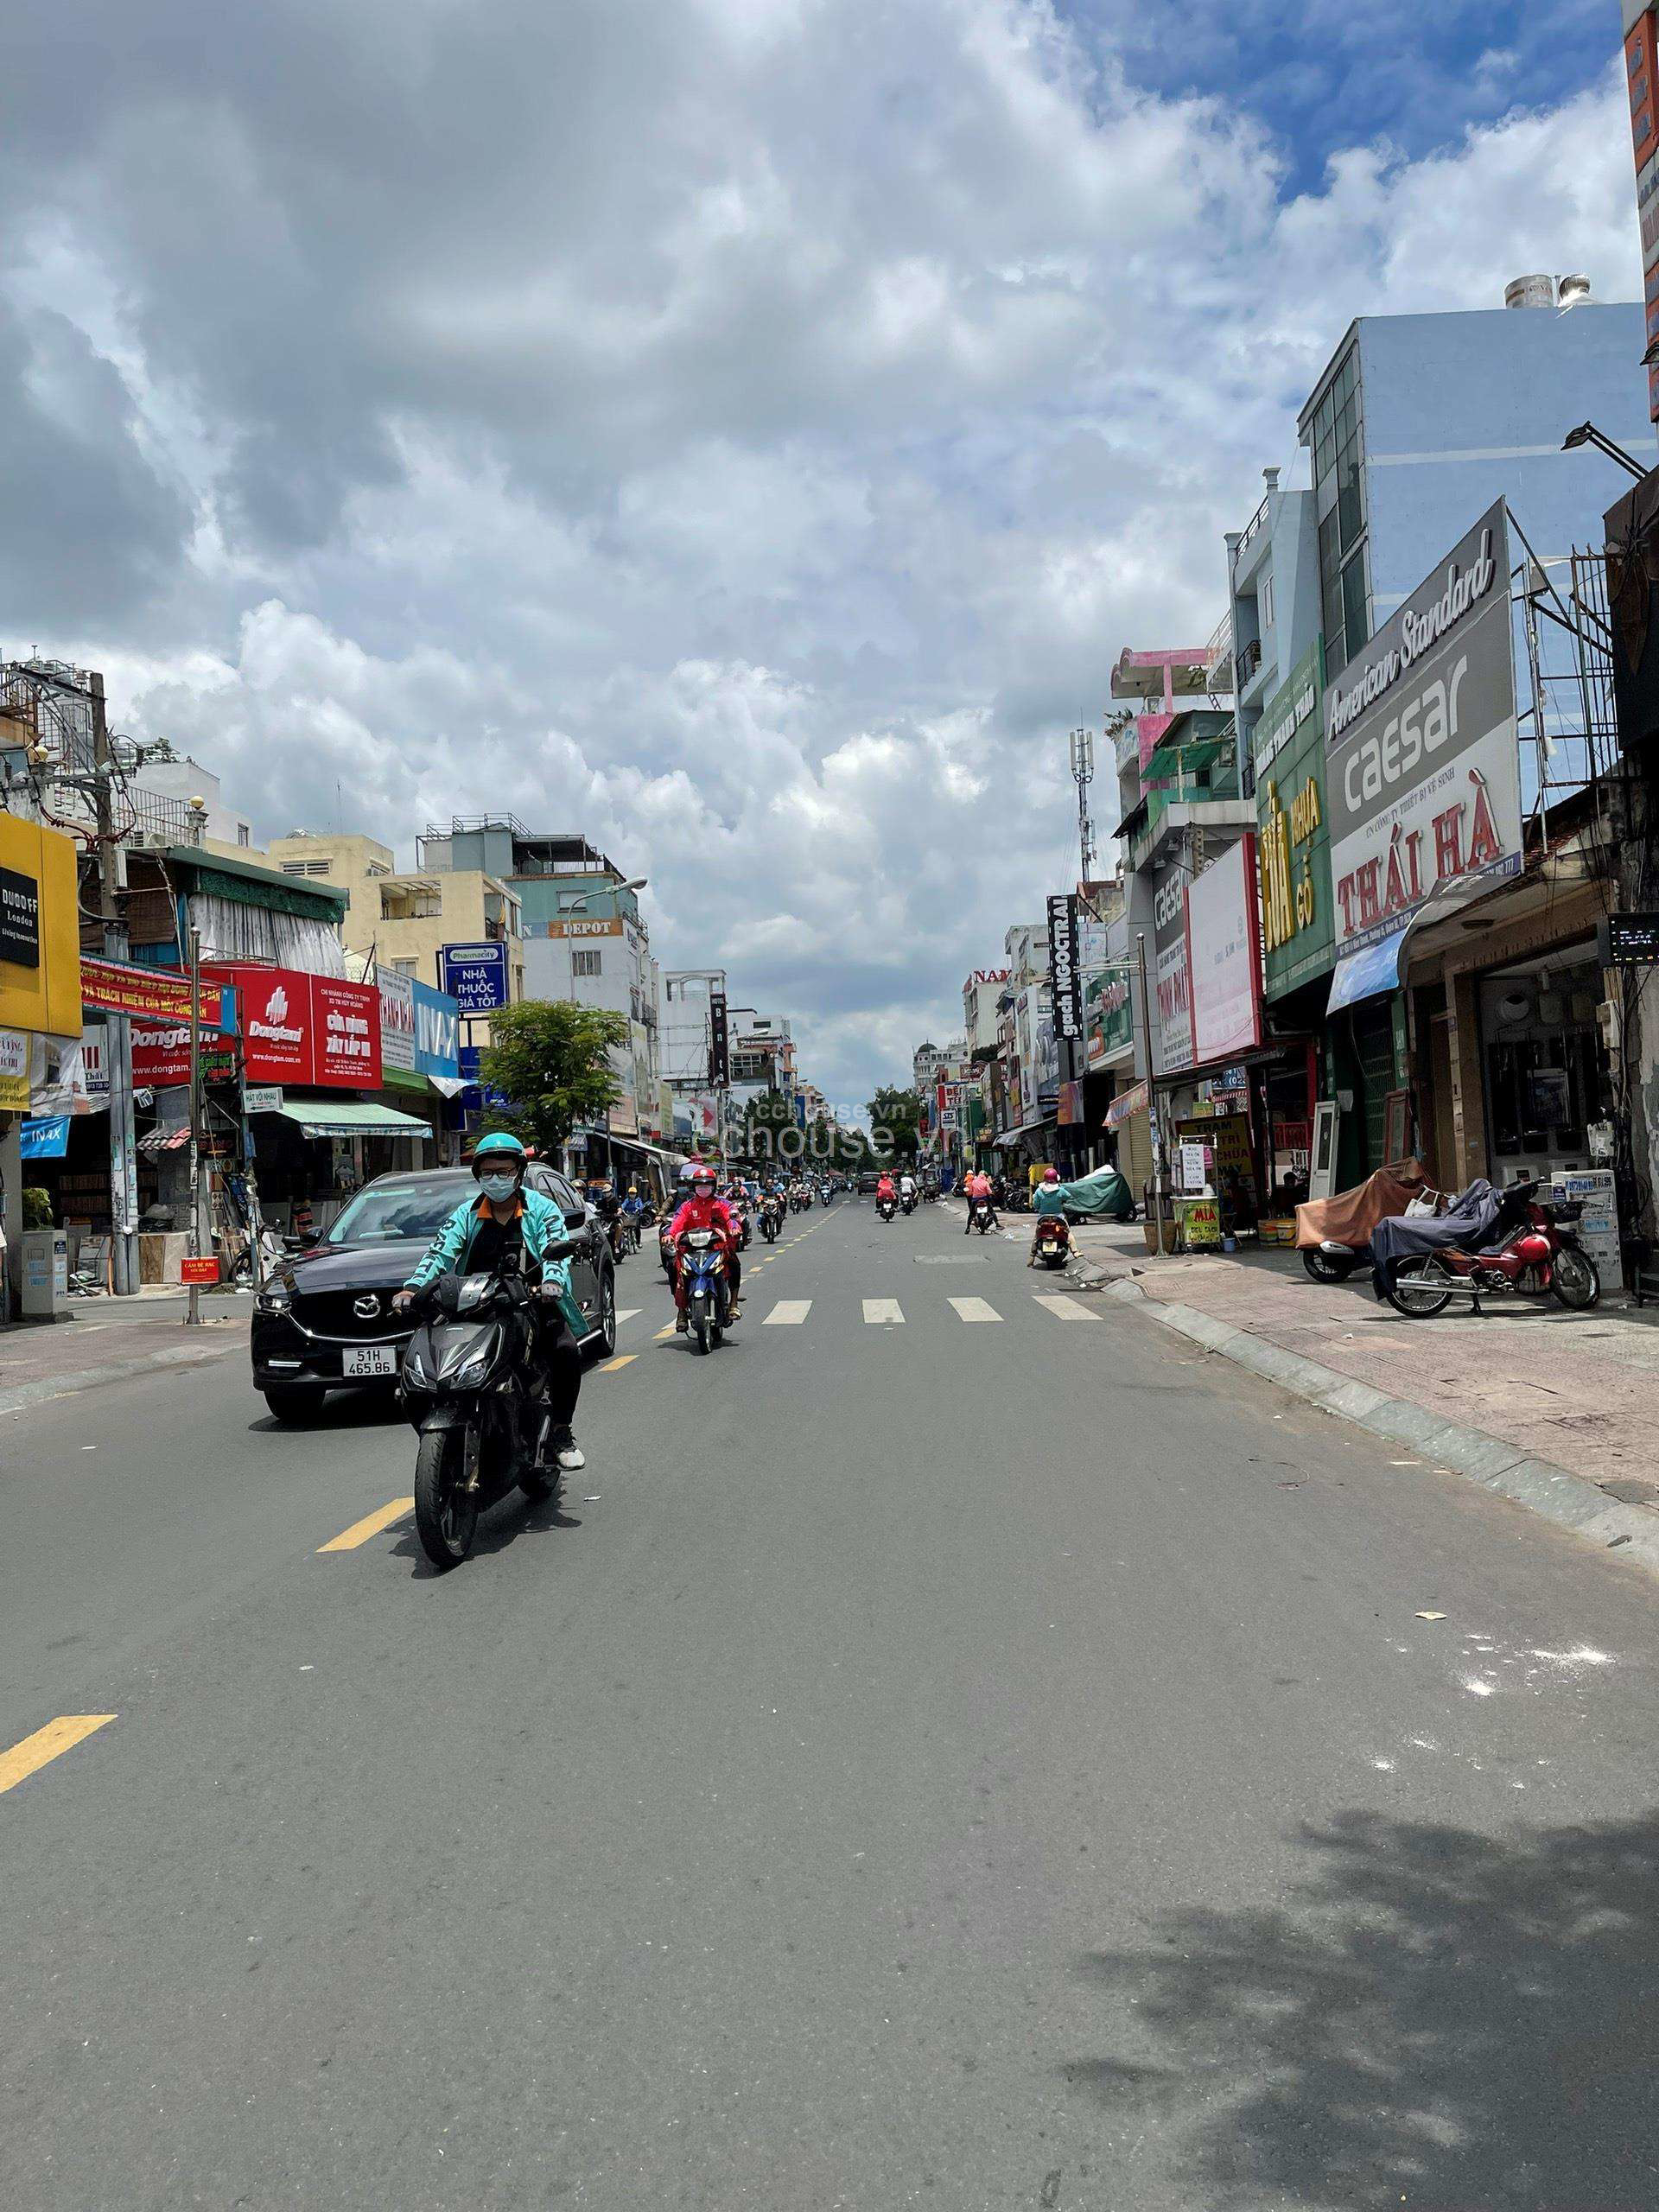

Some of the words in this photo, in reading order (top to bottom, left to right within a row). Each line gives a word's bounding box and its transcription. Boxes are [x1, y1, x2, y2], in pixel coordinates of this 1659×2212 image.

[1328, 651, 1400, 741] American
[1401, 529, 1493, 668] Standard
[1344, 655, 1467, 812] caesar
[1338, 822, 1426, 938] THÁI
[1432, 767, 1505, 879] HÀ
[7, 911, 33, 927] London
[563, 922, 611, 935] DEPOT
[453, 951, 495, 960] Pharmacity
[462, 967, 486, 980] NHÀ
[458, 979, 494, 994] THUỐC
[96, 986, 121, 1003] TRÁCH
[122, 992, 144, 1008] NHIỆM
[458, 996, 474, 1008] GIÁ
[476, 993, 497, 1007] TỐT
[417, 1002, 457, 1062] INAX
[32, 1128, 60, 1142] INAX
[357, 1350, 380, 1362] 51H
[349, 1362, 391, 1374] 465.86
